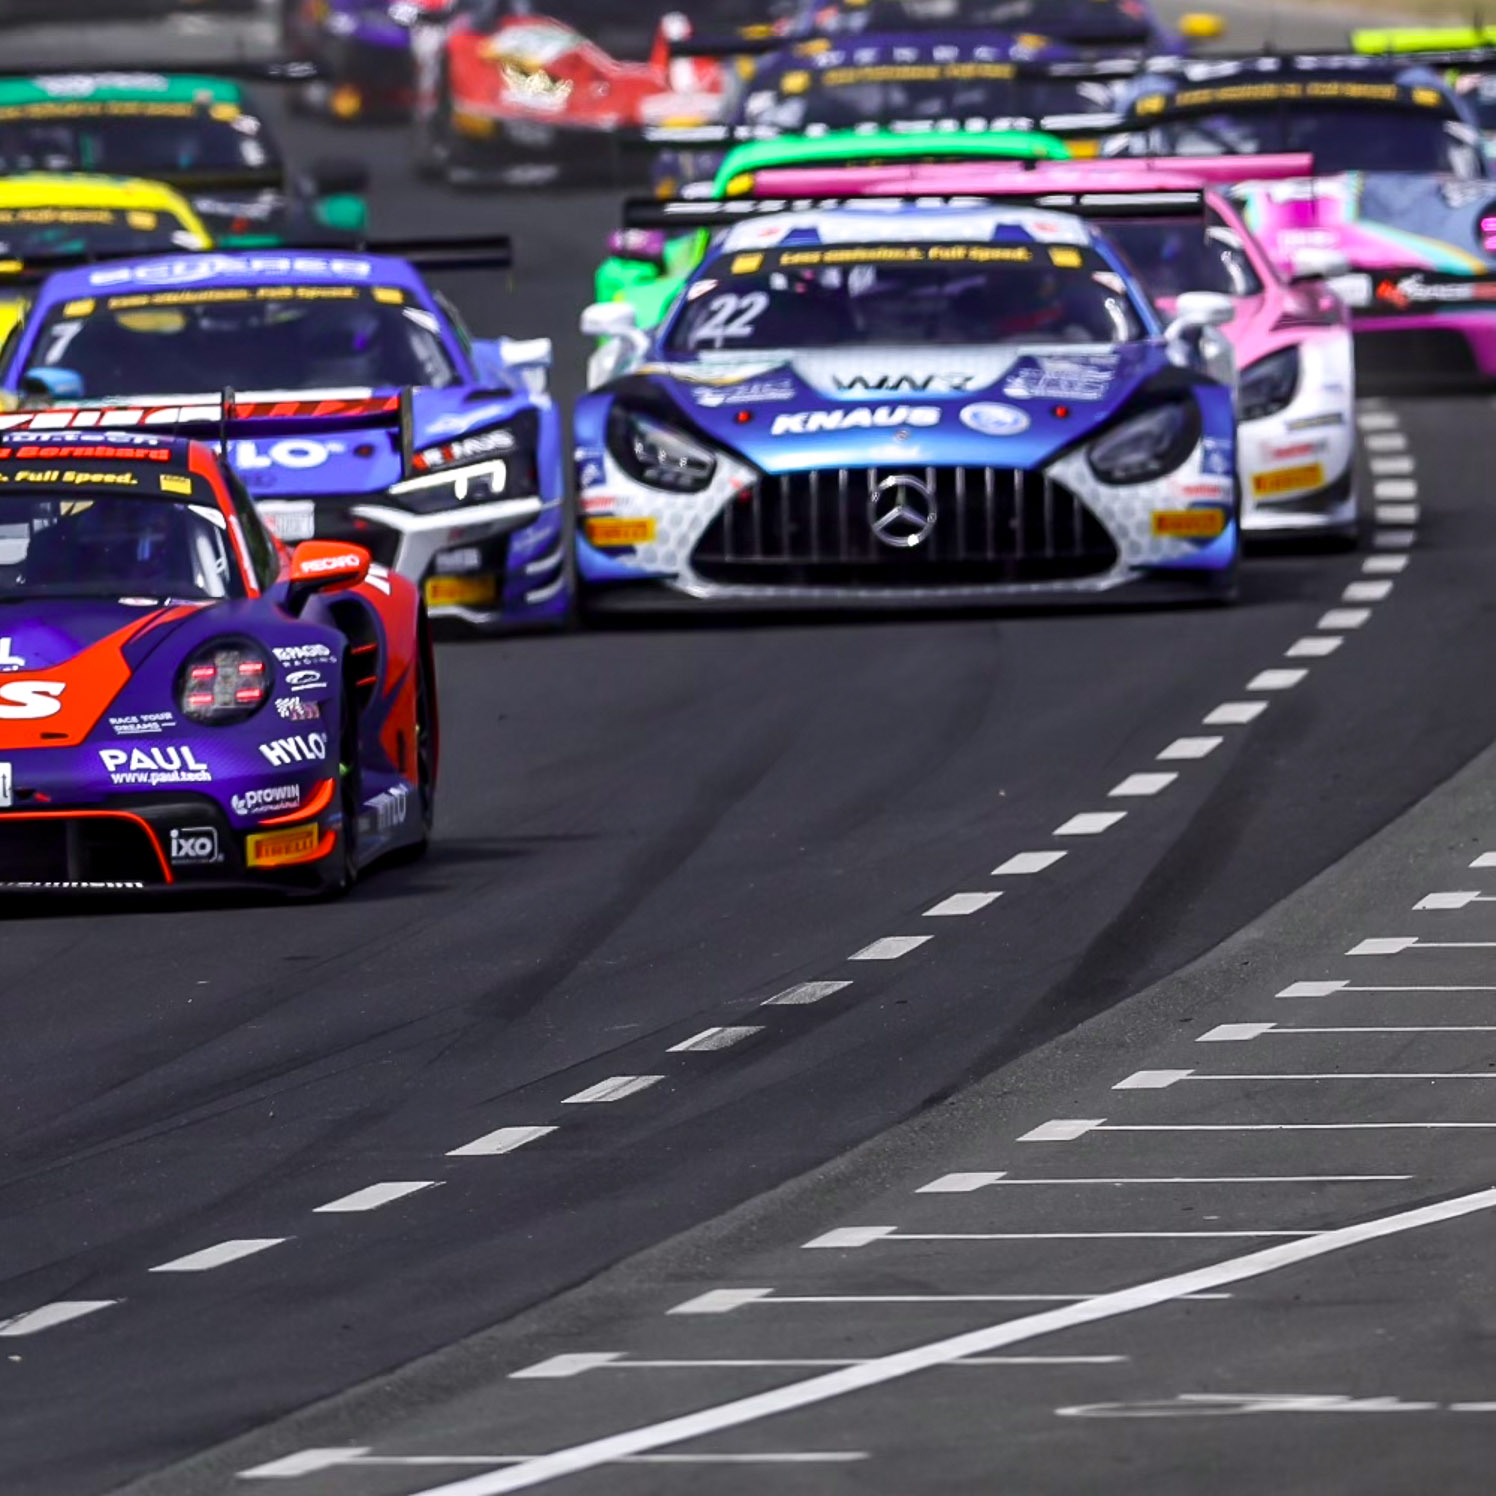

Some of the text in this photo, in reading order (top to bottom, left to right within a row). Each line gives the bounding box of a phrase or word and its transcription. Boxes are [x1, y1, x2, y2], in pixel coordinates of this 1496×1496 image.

[770, 405, 943, 437] KNAUS
[234, 439, 329, 470] LO
[14, 469, 60, 484] Full
[62, 470, 139, 486] Speed.
[98, 746, 208, 772] PAUL
[258, 732, 326, 767] HYLO
[110, 769, 212, 786] www.paul.tech
[169, 828, 213, 857] ixo
